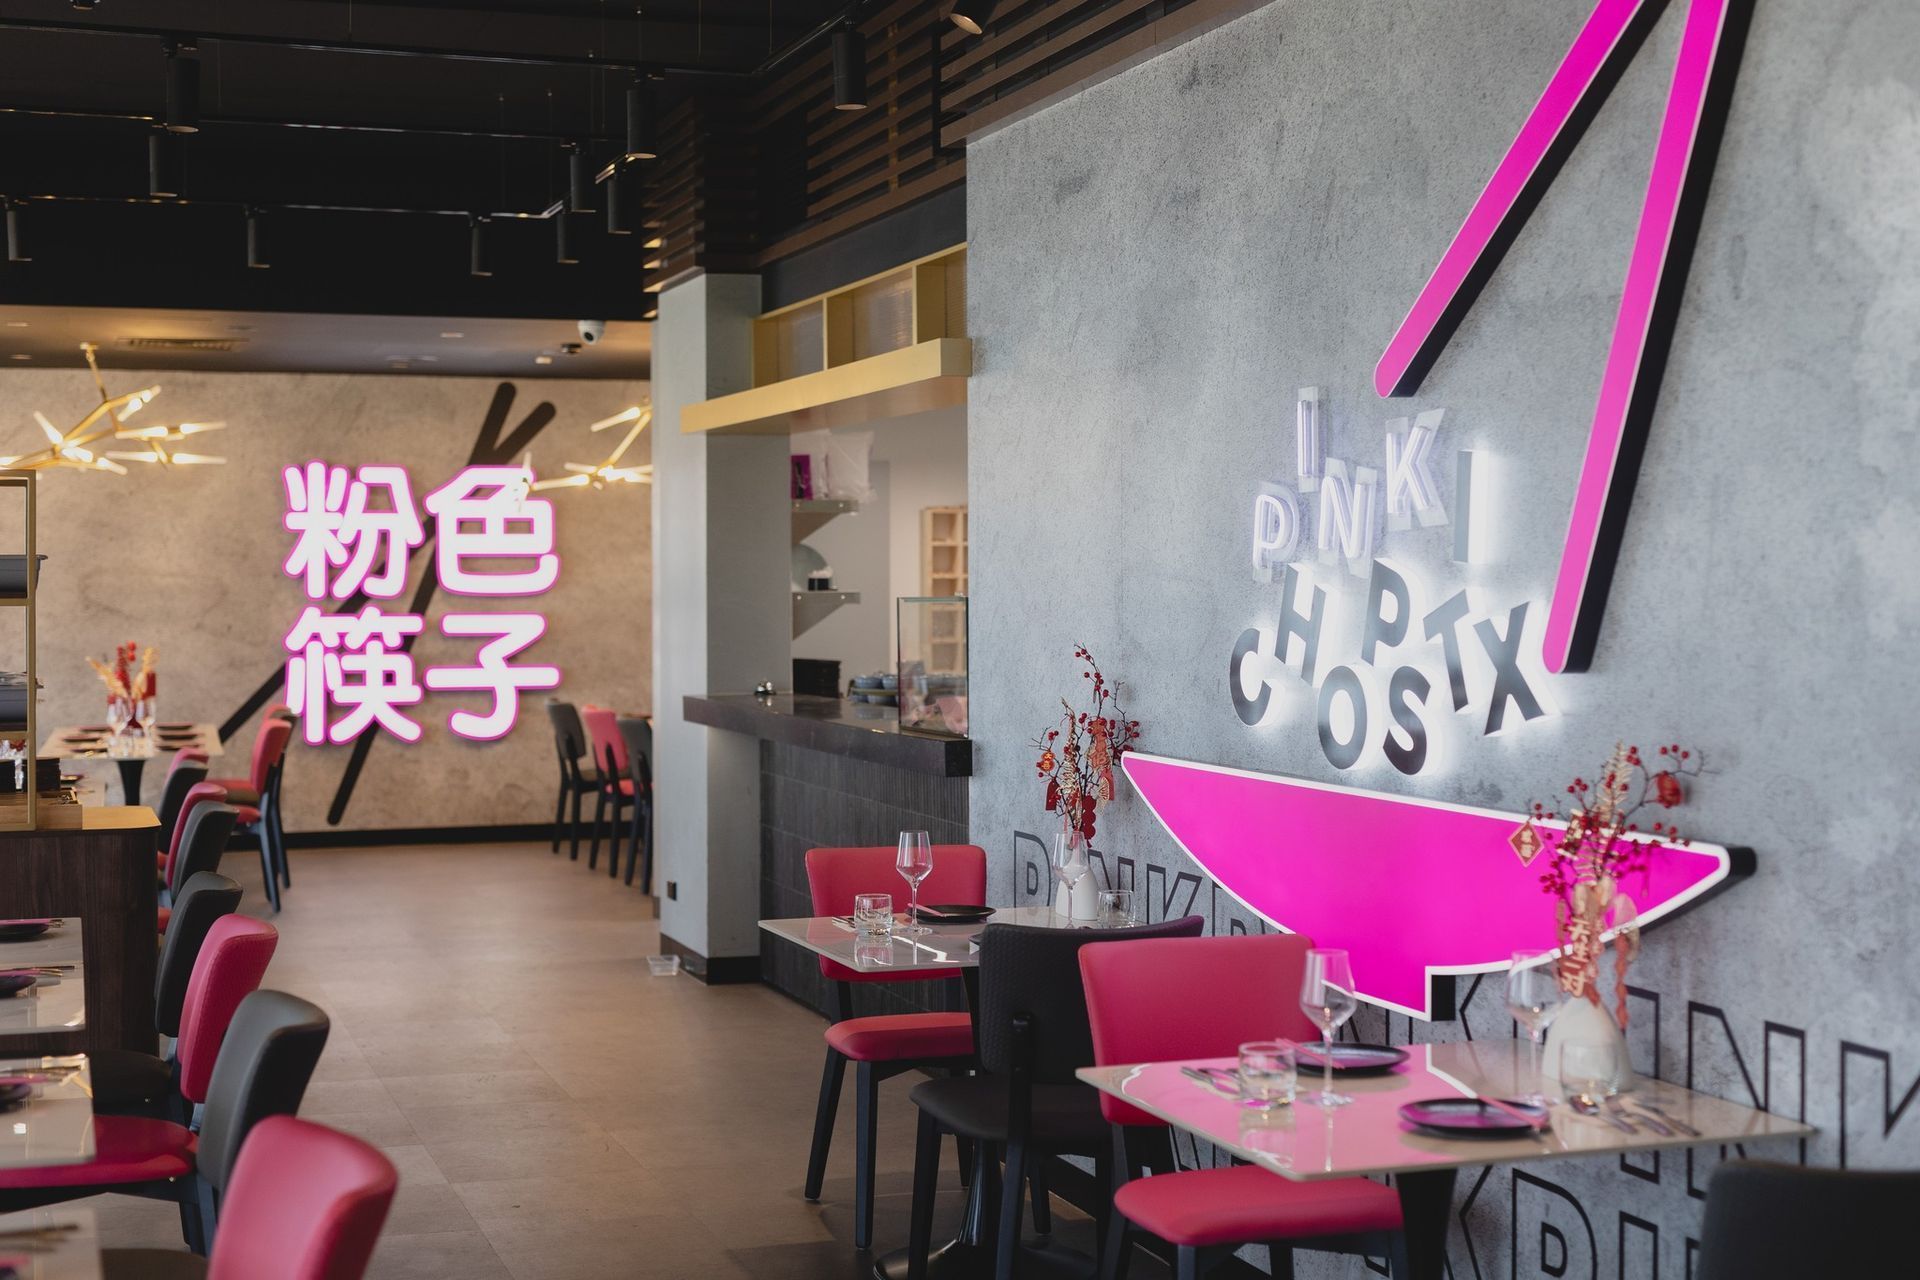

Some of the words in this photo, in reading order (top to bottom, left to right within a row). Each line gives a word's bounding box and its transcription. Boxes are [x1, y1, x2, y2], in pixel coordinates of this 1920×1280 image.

[281, 458, 559, 599] 粉色
[1252, 386, 1449, 583] PINK
[283, 604, 562, 745] 筷子
[1013, 830, 1203, 930] PNK
